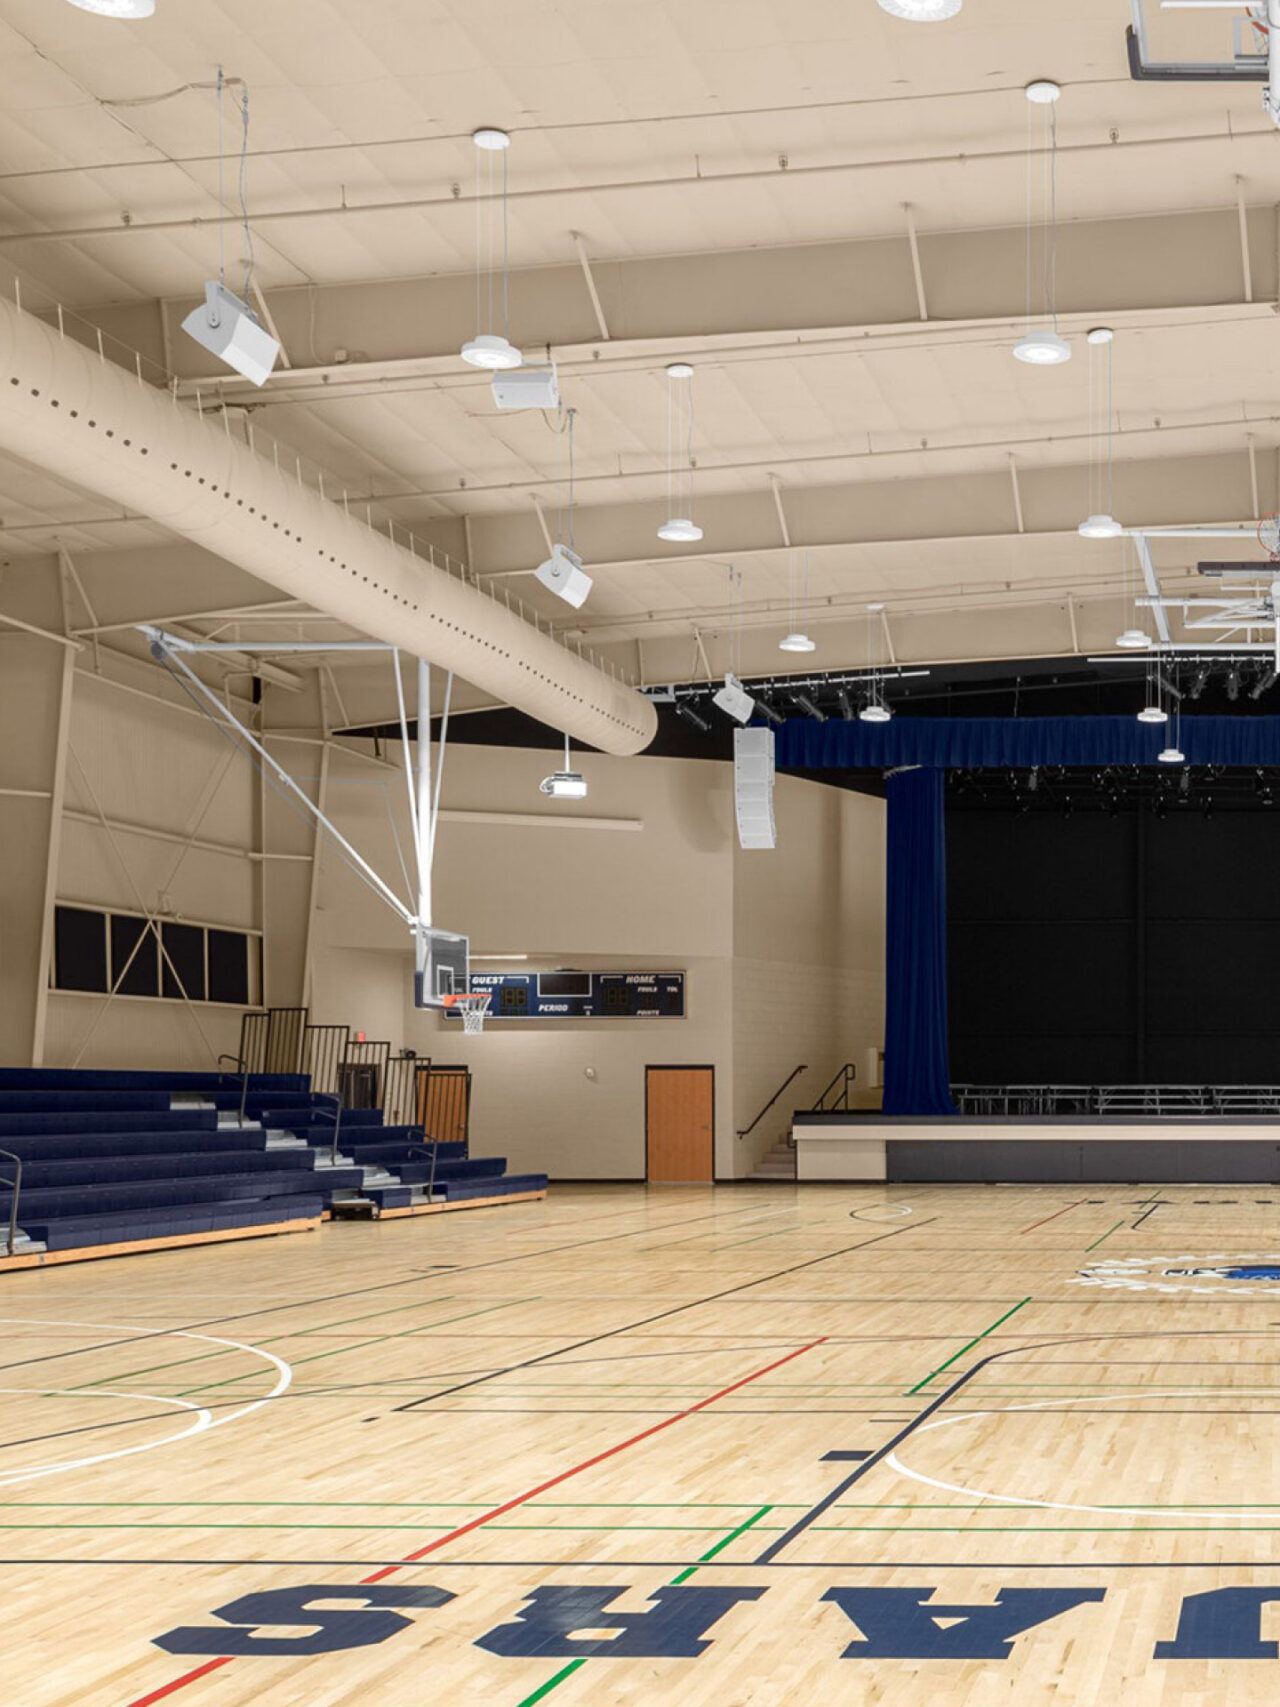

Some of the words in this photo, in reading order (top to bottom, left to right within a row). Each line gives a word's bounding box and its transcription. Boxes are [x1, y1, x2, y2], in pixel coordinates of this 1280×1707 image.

[471, 976, 505, 985] GUEST
[625, 975, 656, 984] HOME
[538, 1004, 569, 1012] PERIOD
